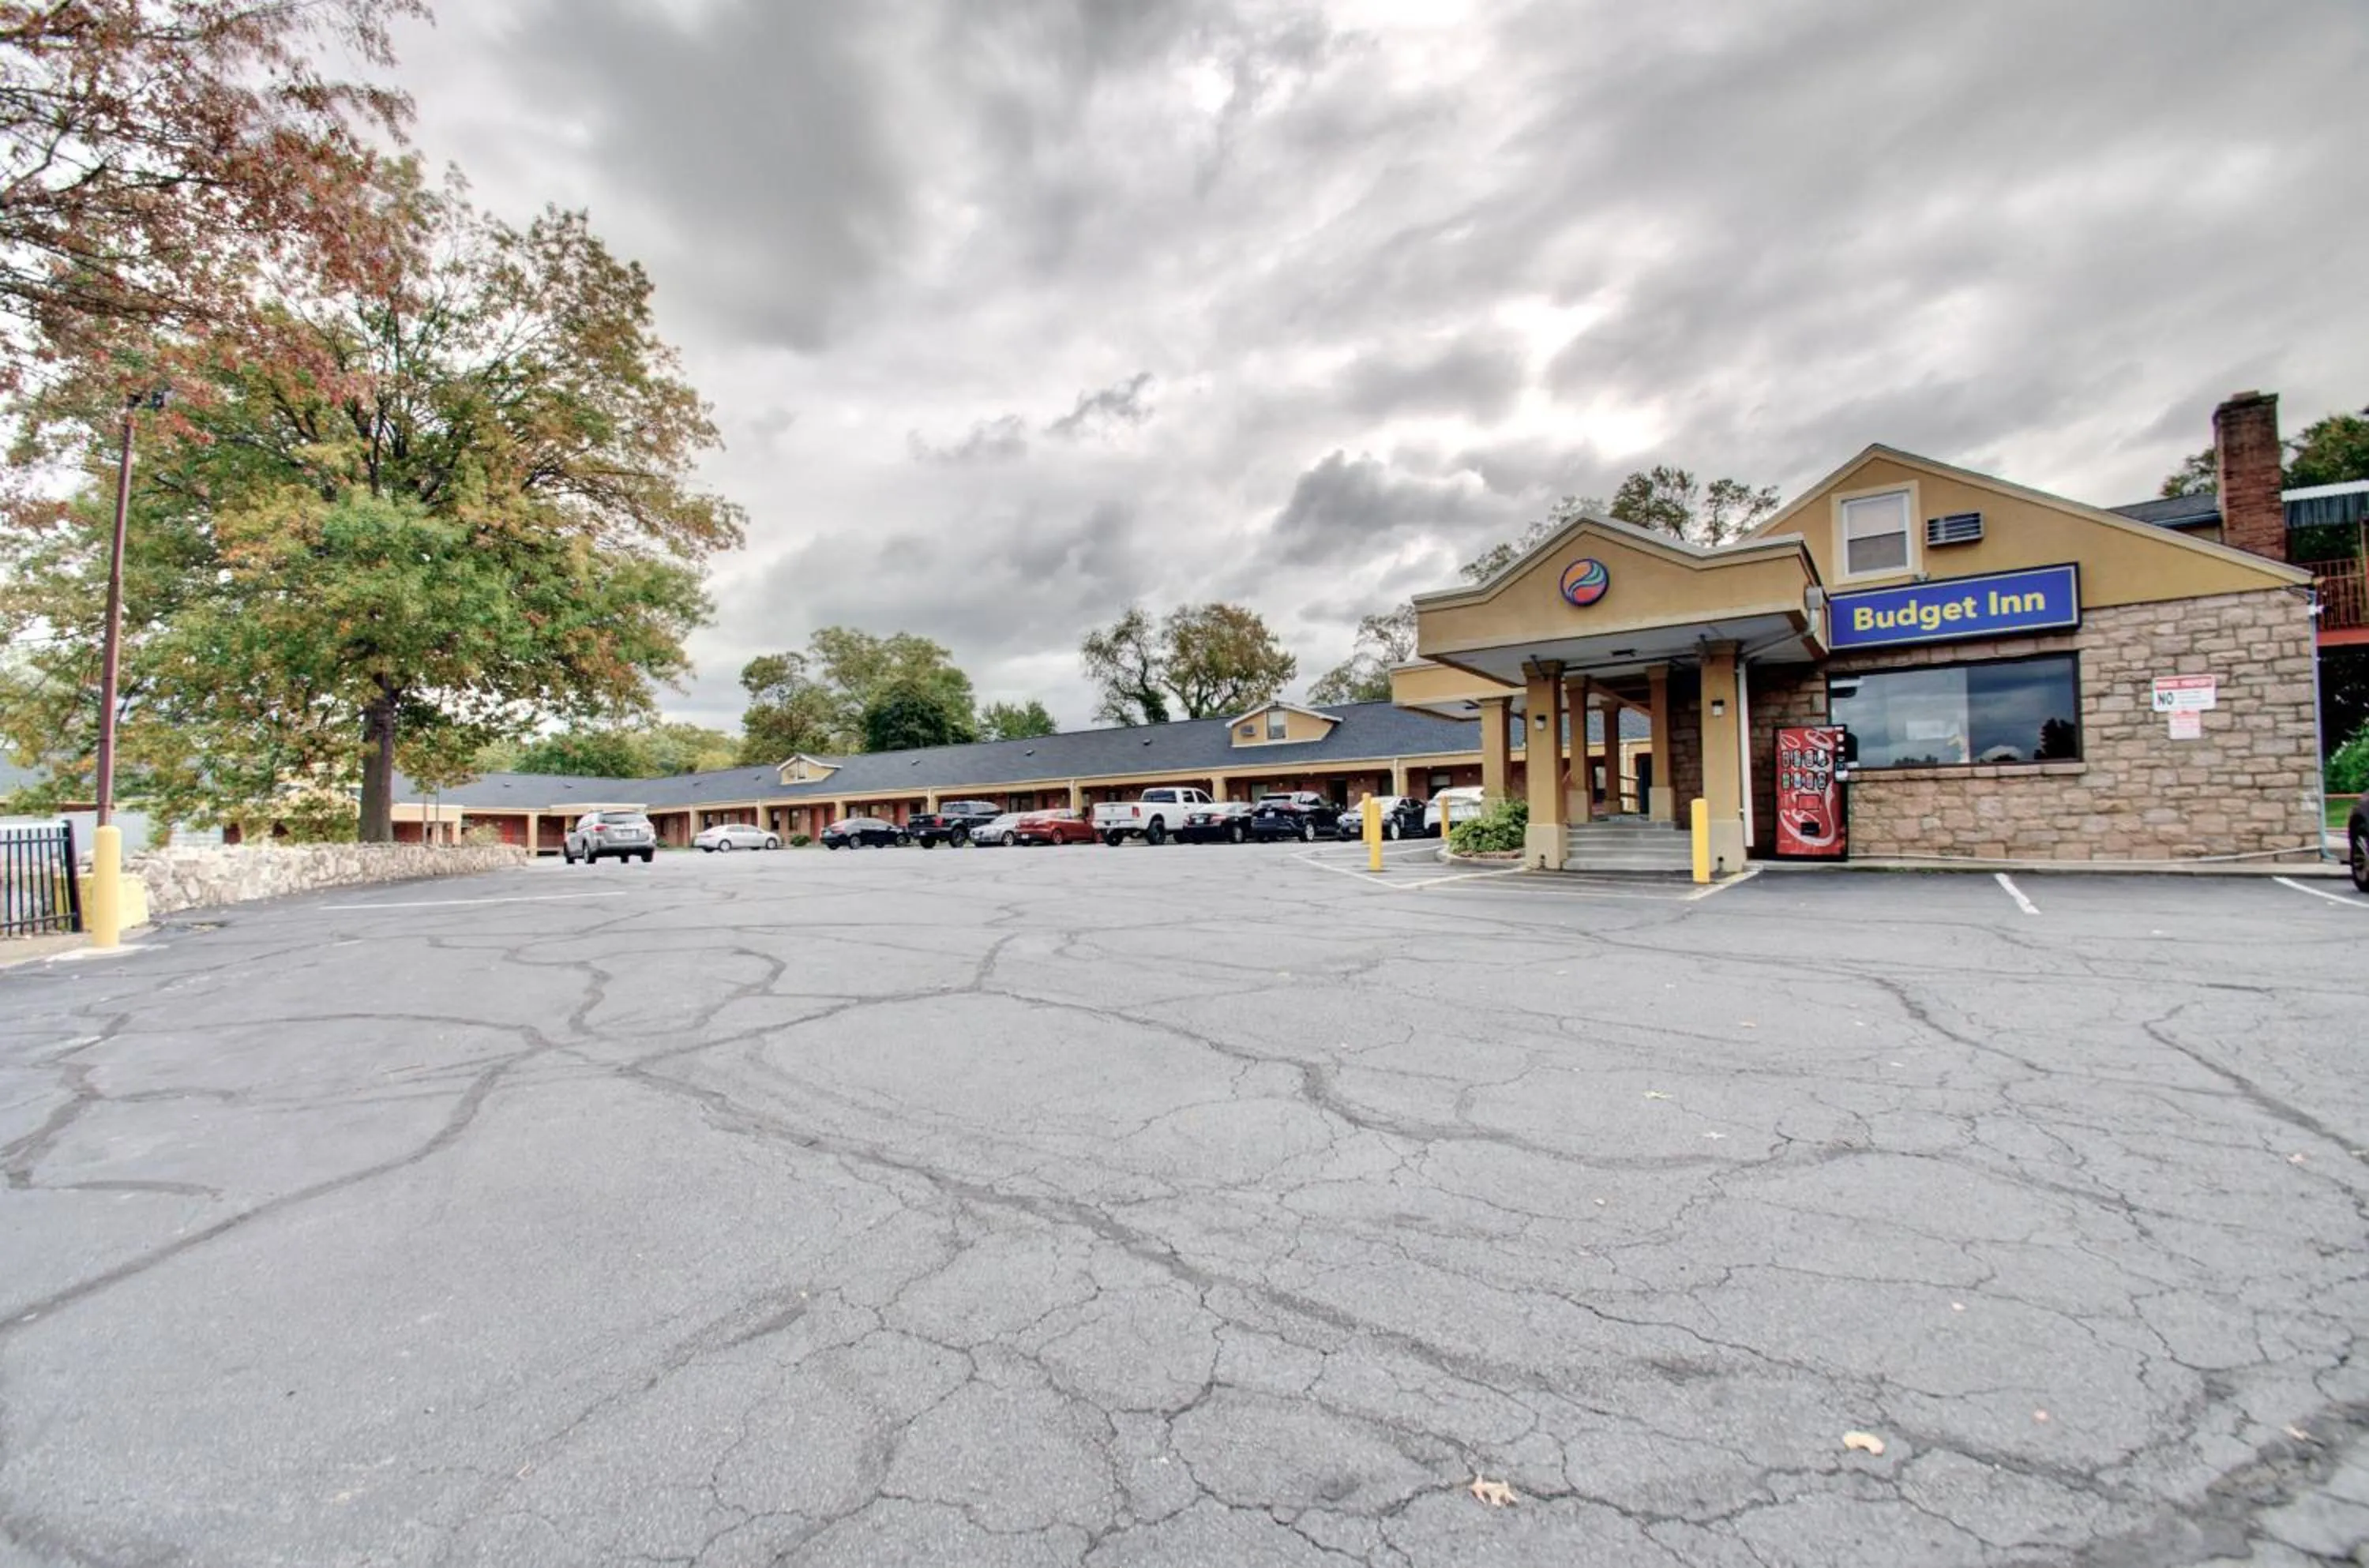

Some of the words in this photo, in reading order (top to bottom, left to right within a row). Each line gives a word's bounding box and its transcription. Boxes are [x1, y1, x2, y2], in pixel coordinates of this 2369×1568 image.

[1853, 597, 1978, 631] Budget
[1988, 591, 2046, 616] Inn
[2157, 692, 2174, 706] NO
